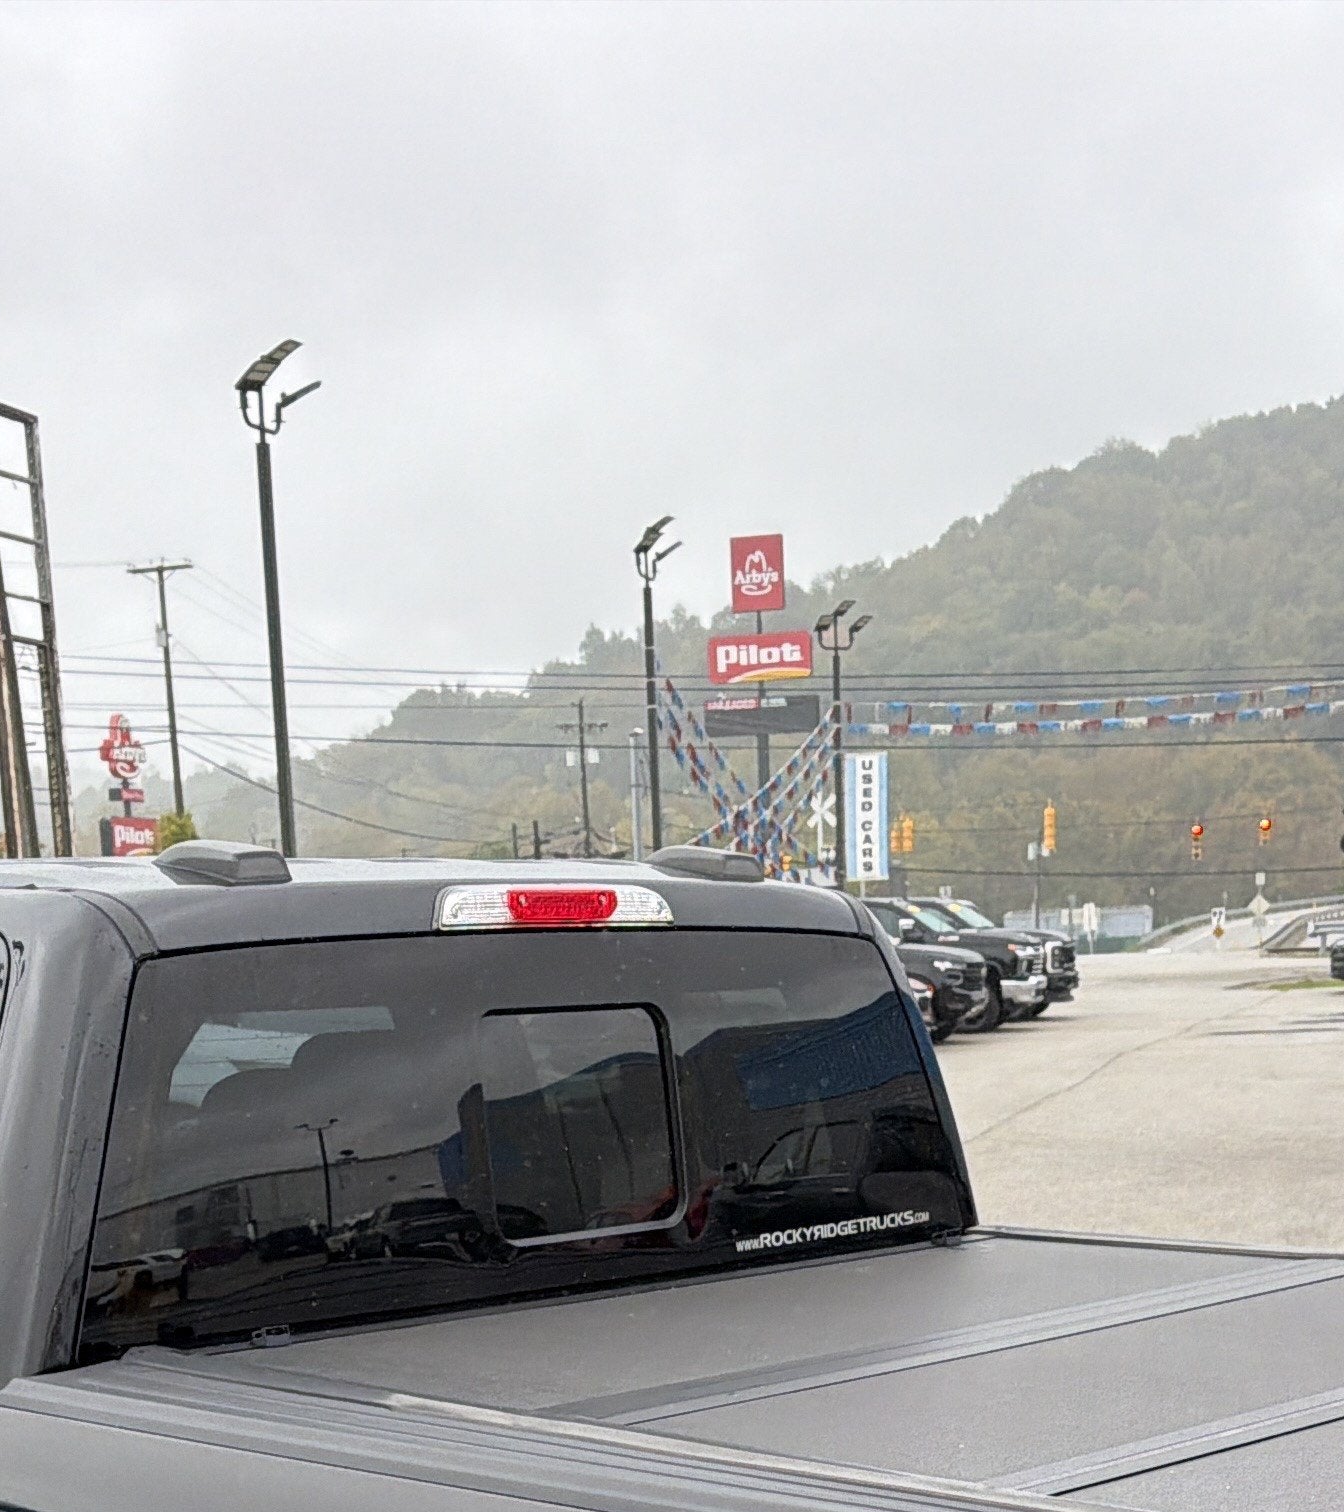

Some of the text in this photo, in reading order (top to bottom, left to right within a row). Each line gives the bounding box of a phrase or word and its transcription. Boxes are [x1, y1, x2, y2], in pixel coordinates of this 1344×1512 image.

[734, 567, 779, 587] Arby's
[716, 642, 803, 673] Pilot
[860, 760, 873, 872] USED CARS
